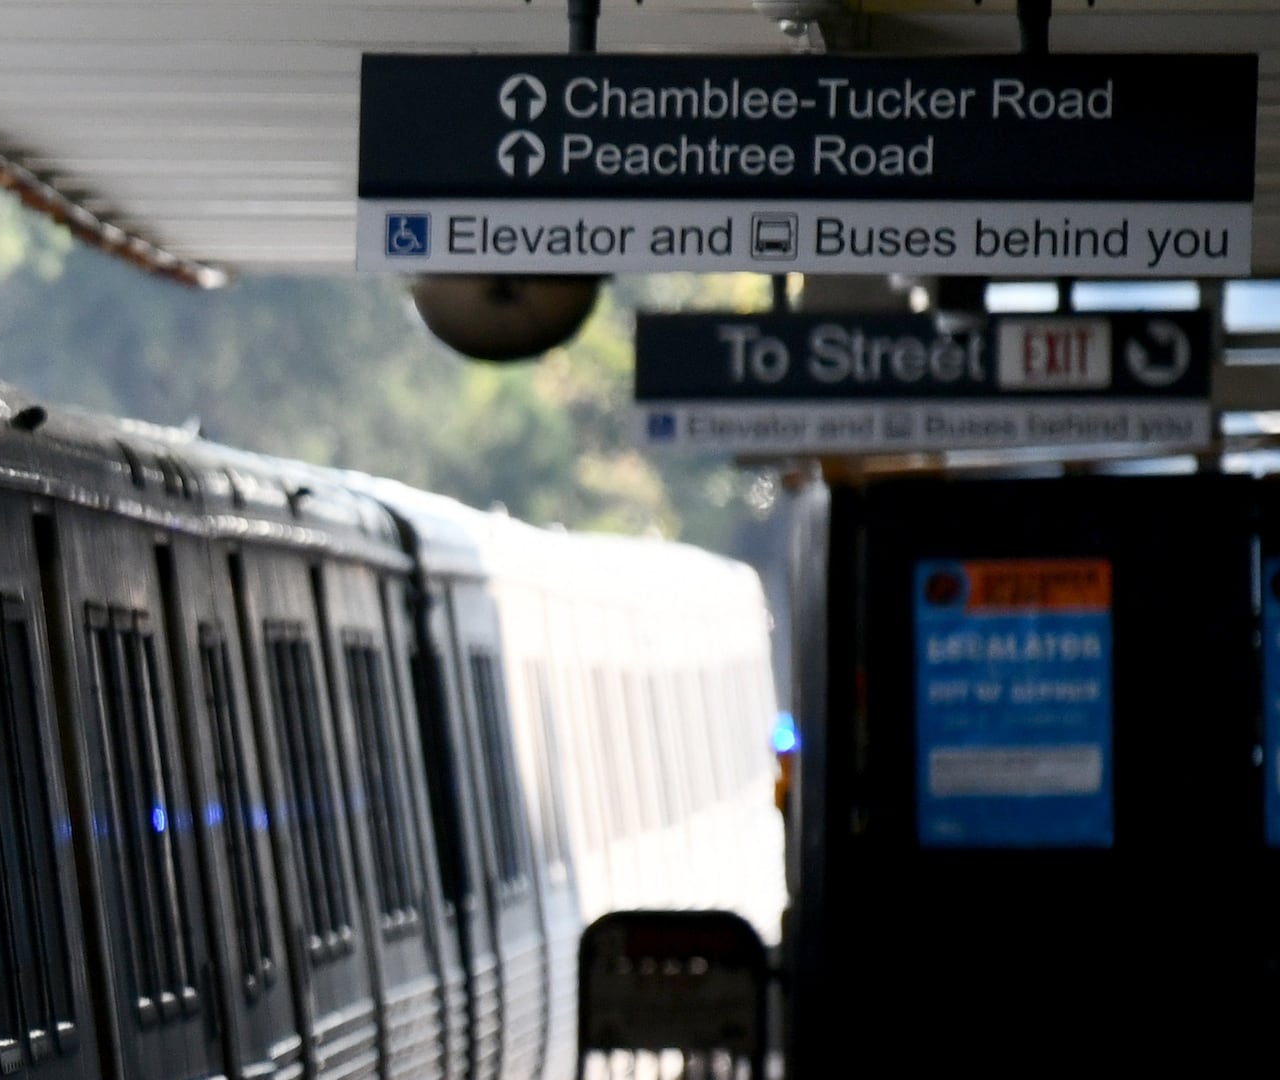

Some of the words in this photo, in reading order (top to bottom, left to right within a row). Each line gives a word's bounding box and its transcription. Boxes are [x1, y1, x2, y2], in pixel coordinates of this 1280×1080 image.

[564, 77, 976, 120] Chamblee-Tucker
[993, 78, 1113, 120] Road
[562, 134, 796, 176] Peachtree
[813, 134, 934, 176] Road
[448, 216, 635, 256] Elevator
[650, 217, 733, 256] and
[815, 217, 957, 257] Buses
[975, 218, 1129, 257] behind
[1147, 227, 1229, 268] you
[716, 323, 789, 383] To
[808, 323, 987, 383] Street
[1022, 328, 1094, 376] EXIT
